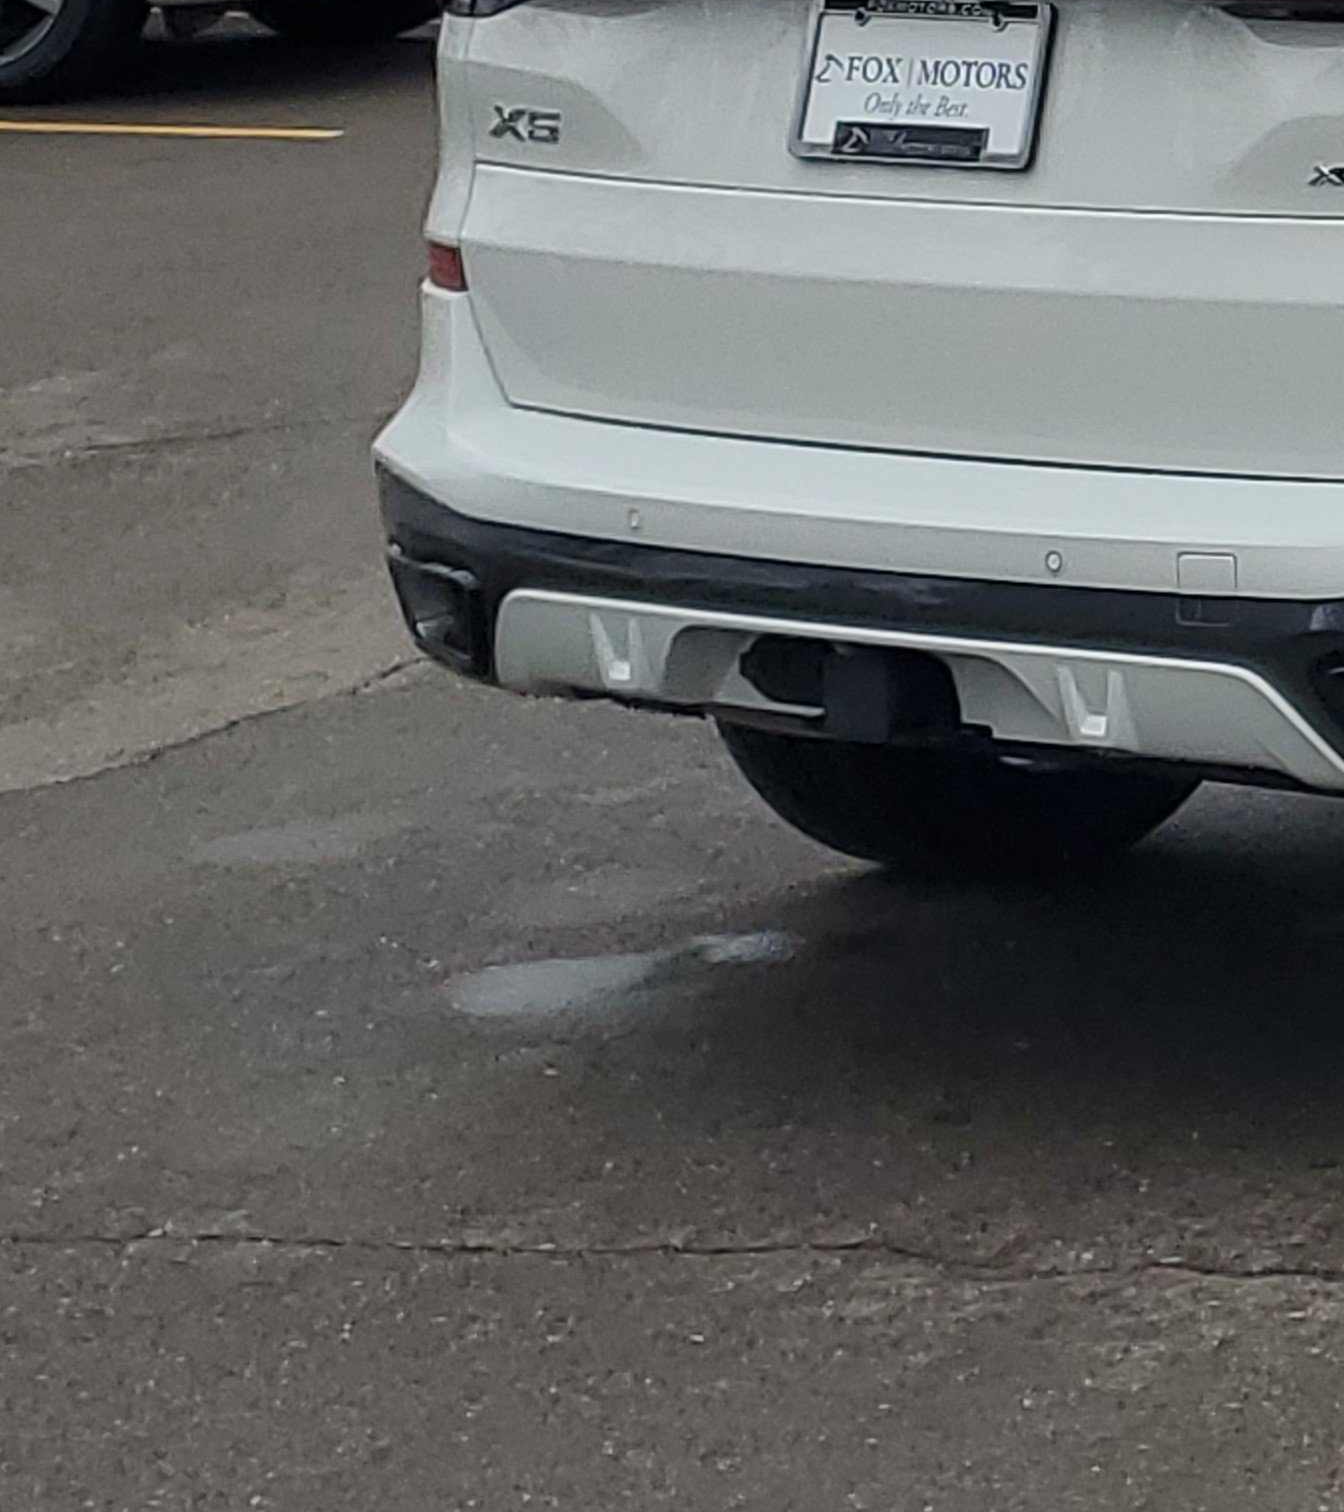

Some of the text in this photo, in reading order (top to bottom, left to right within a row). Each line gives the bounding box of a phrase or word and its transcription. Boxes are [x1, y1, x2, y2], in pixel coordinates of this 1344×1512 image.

[846, 56, 1029, 90] FOX MOTORS
[864, 92, 902, 116] Only
[906, 94, 930, 115] the
[488, 103, 561, 144] X5
